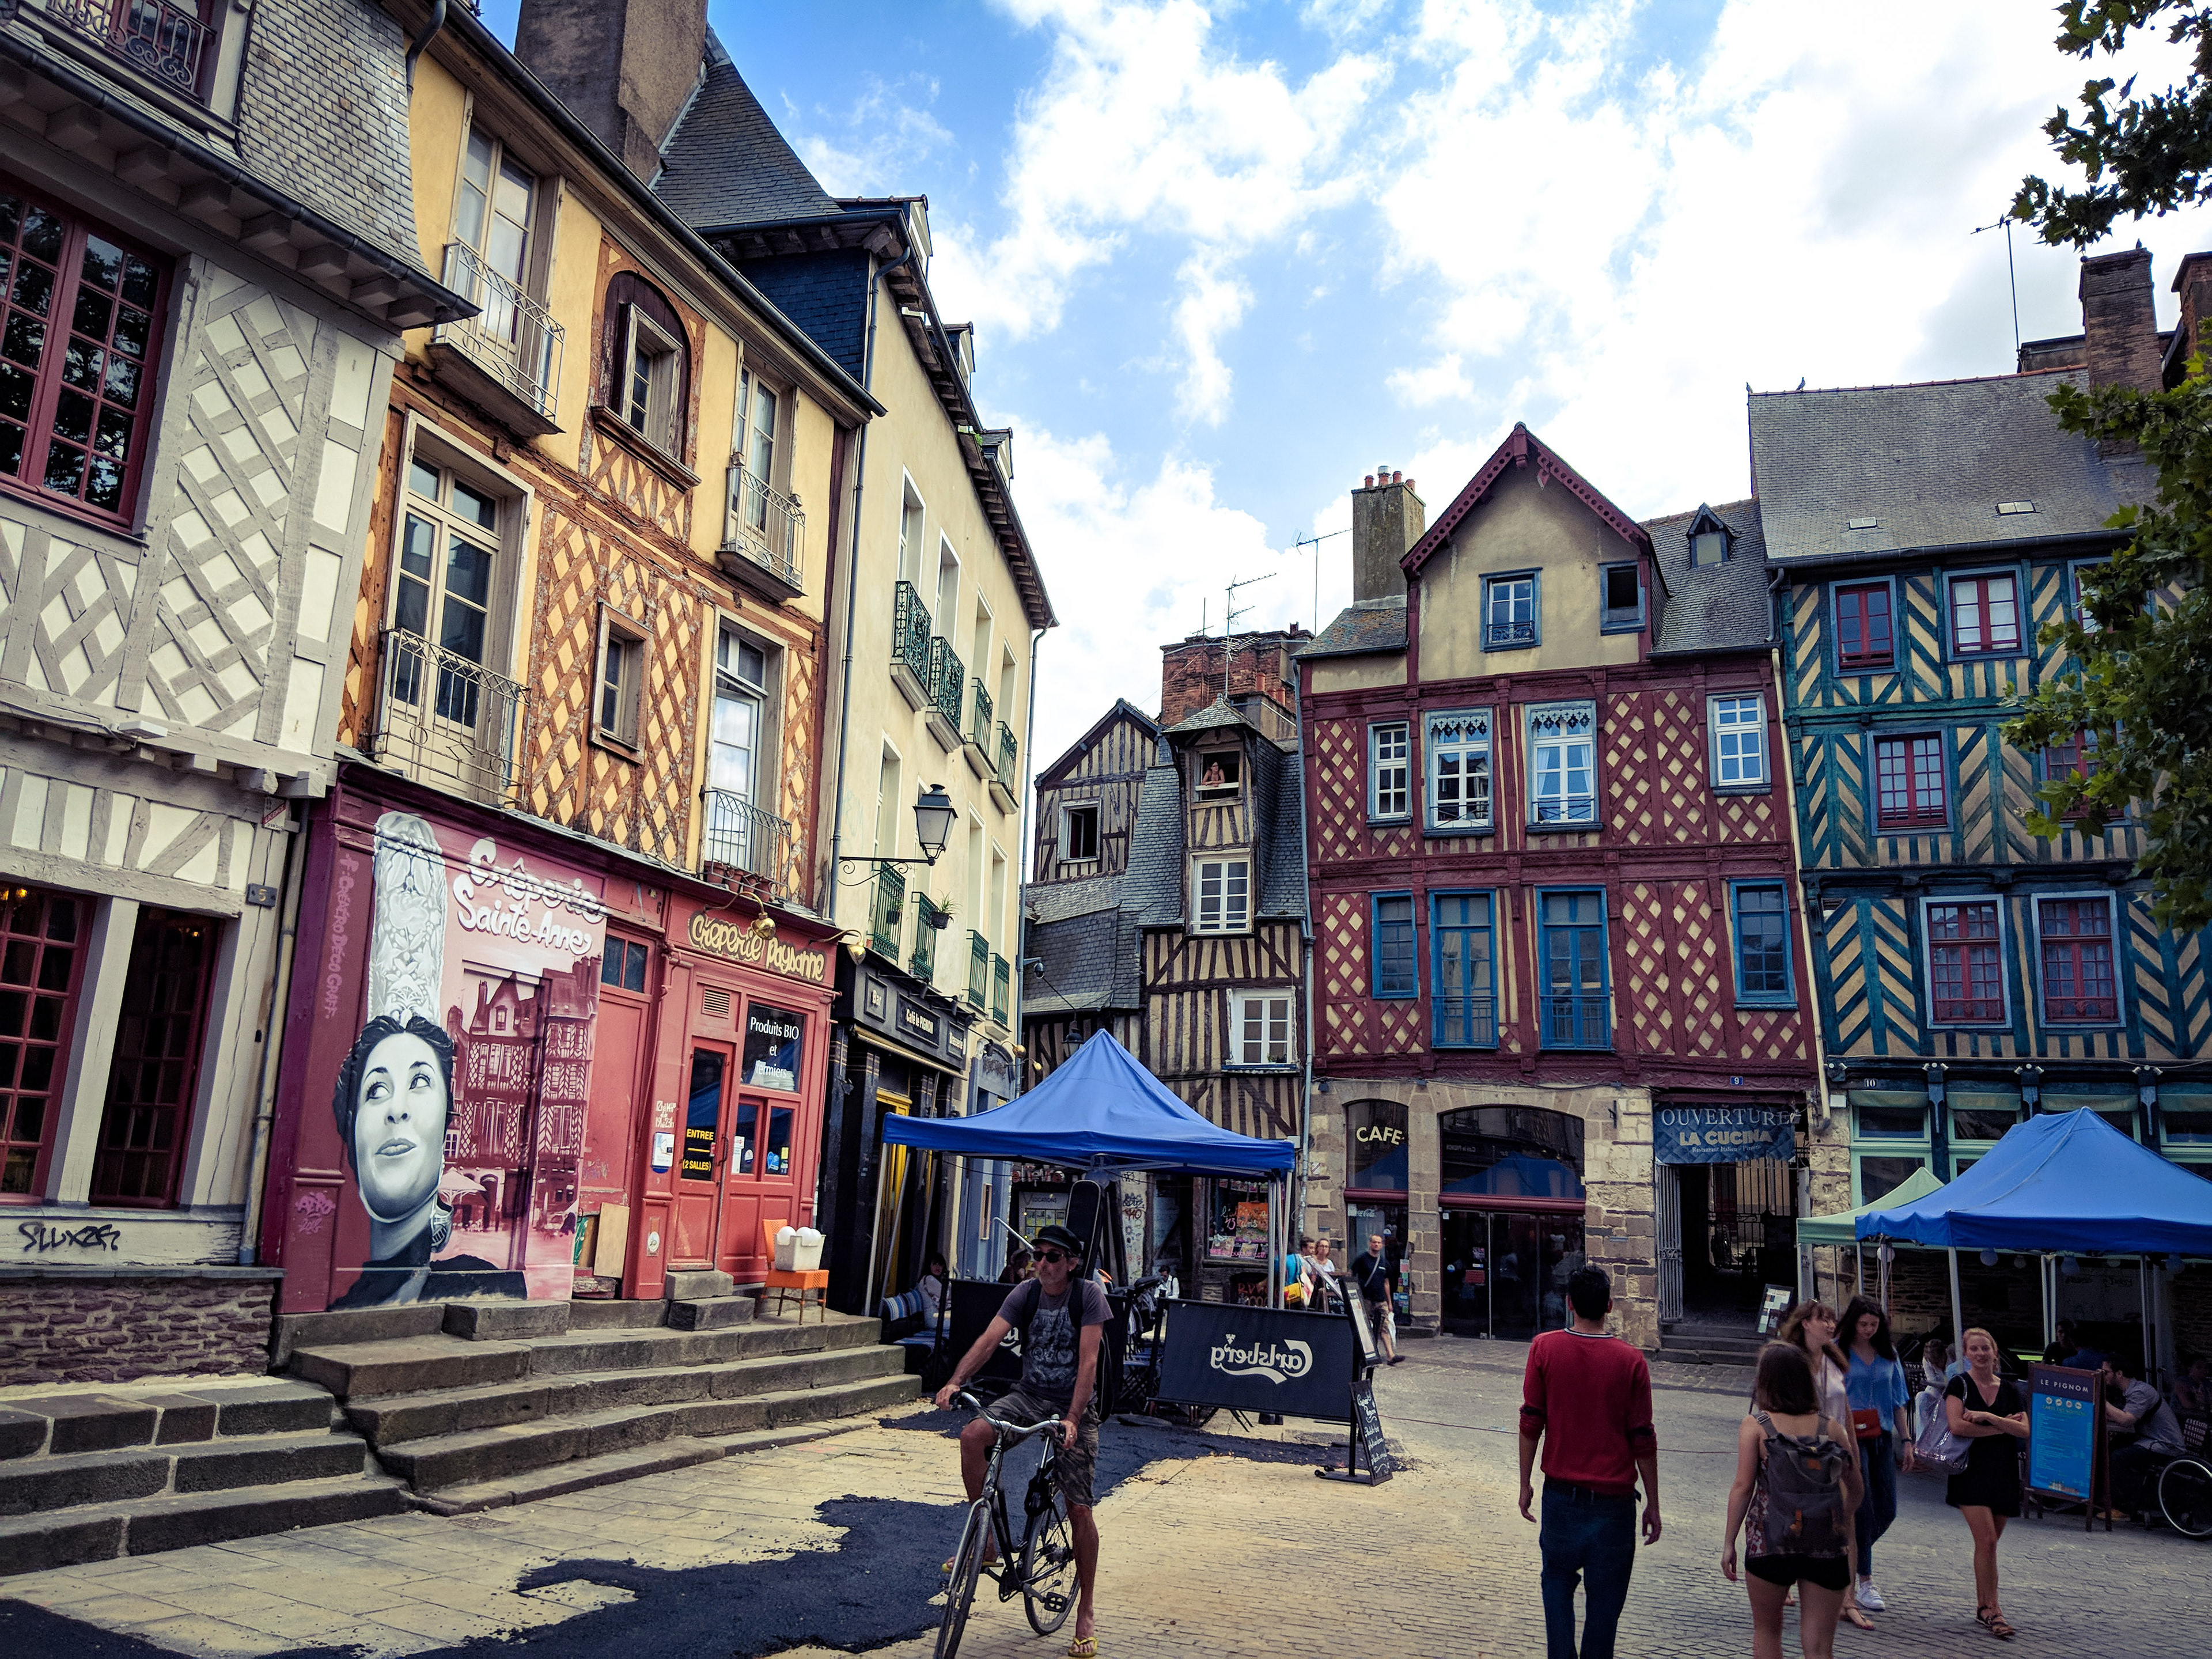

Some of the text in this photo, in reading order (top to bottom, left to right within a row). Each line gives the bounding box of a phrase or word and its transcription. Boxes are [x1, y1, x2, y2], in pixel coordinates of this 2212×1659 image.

[259, 888, 267, 902] 5
[872, 989, 882, 1006] Bar
[750, 1017, 800, 1040] Produits BIO
[769, 1044, 777, 1056] et
[1734, 1077, 1740, 1085] 9
[1866, 1080, 1876, 1088] 10
[1661, 1108, 1790, 1126] OUVERTURE
[686, 1128, 714, 1140] ENTREE
[1679, 1130, 1773, 1146] LA CUCINA
[683, 1158, 688, 1169] (2
[689, 1160, 711, 1172] SALLES)
